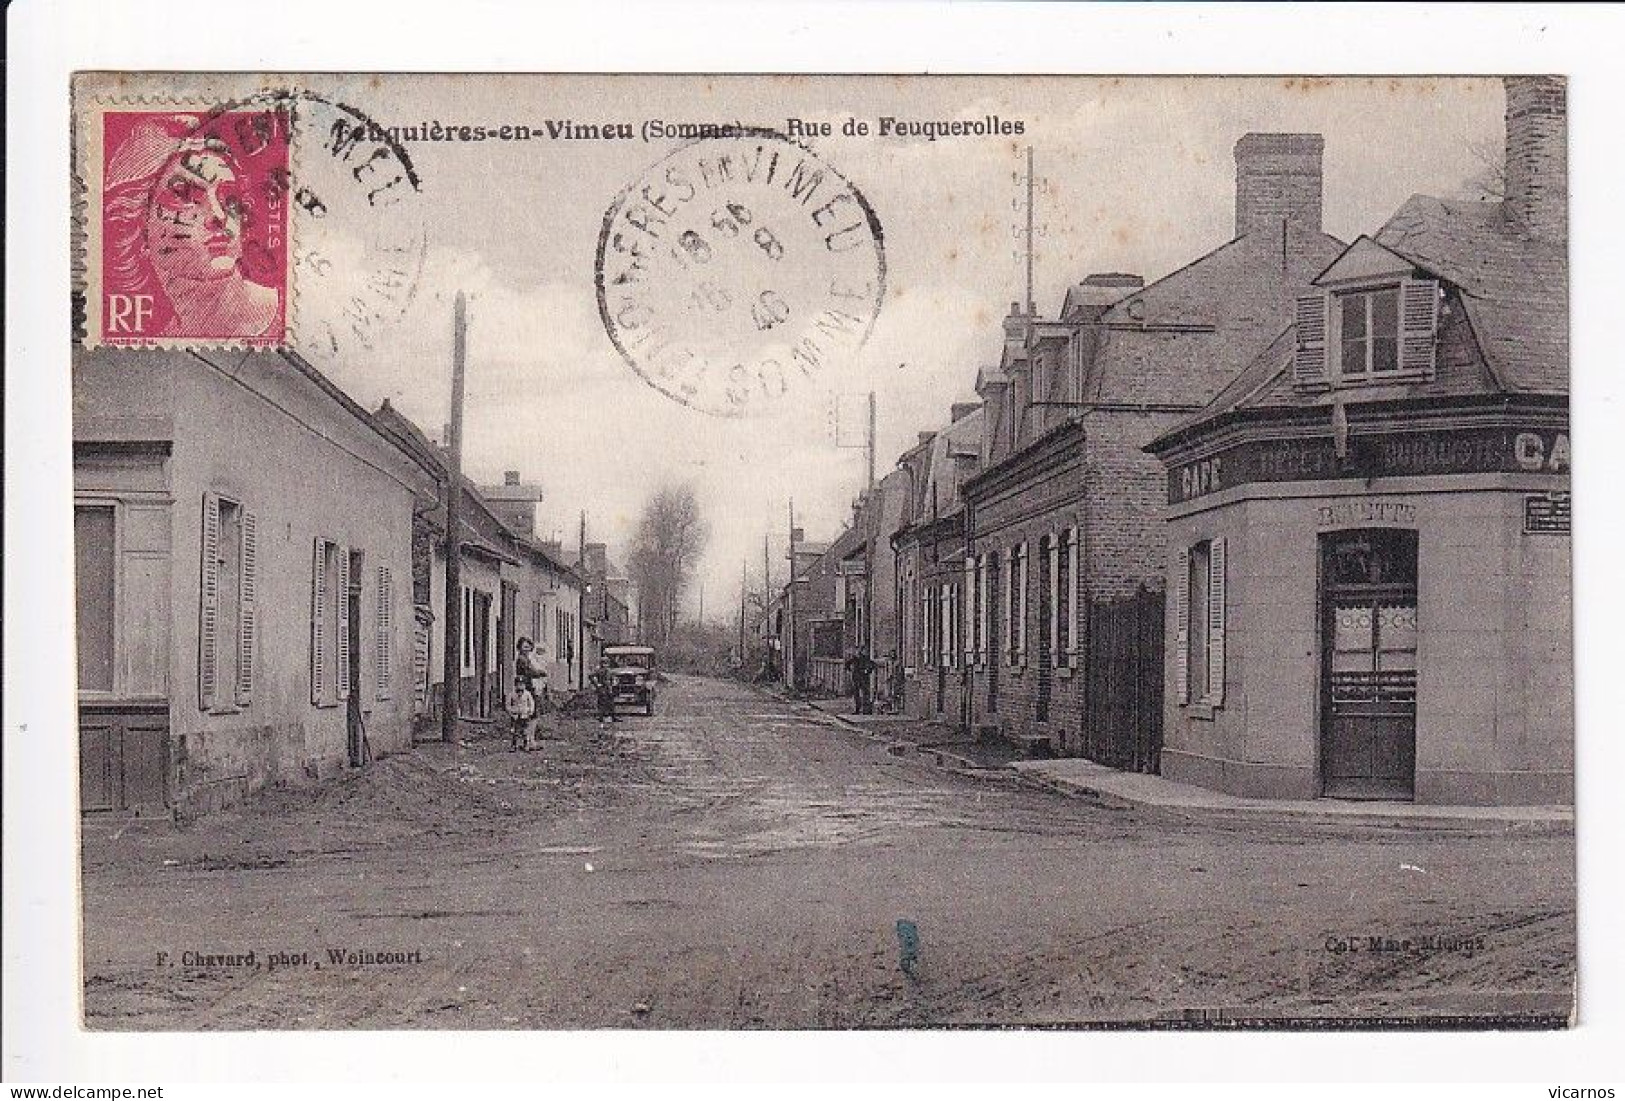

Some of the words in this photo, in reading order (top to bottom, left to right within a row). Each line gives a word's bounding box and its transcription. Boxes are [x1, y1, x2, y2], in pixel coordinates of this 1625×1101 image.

[787, 118, 832, 137] Rue
[843, 117, 869, 136] de
[879, 115, 1025, 141] Feuquerolles
[107, 294, 154, 333] RF
[156, 951, 174, 968] F.
